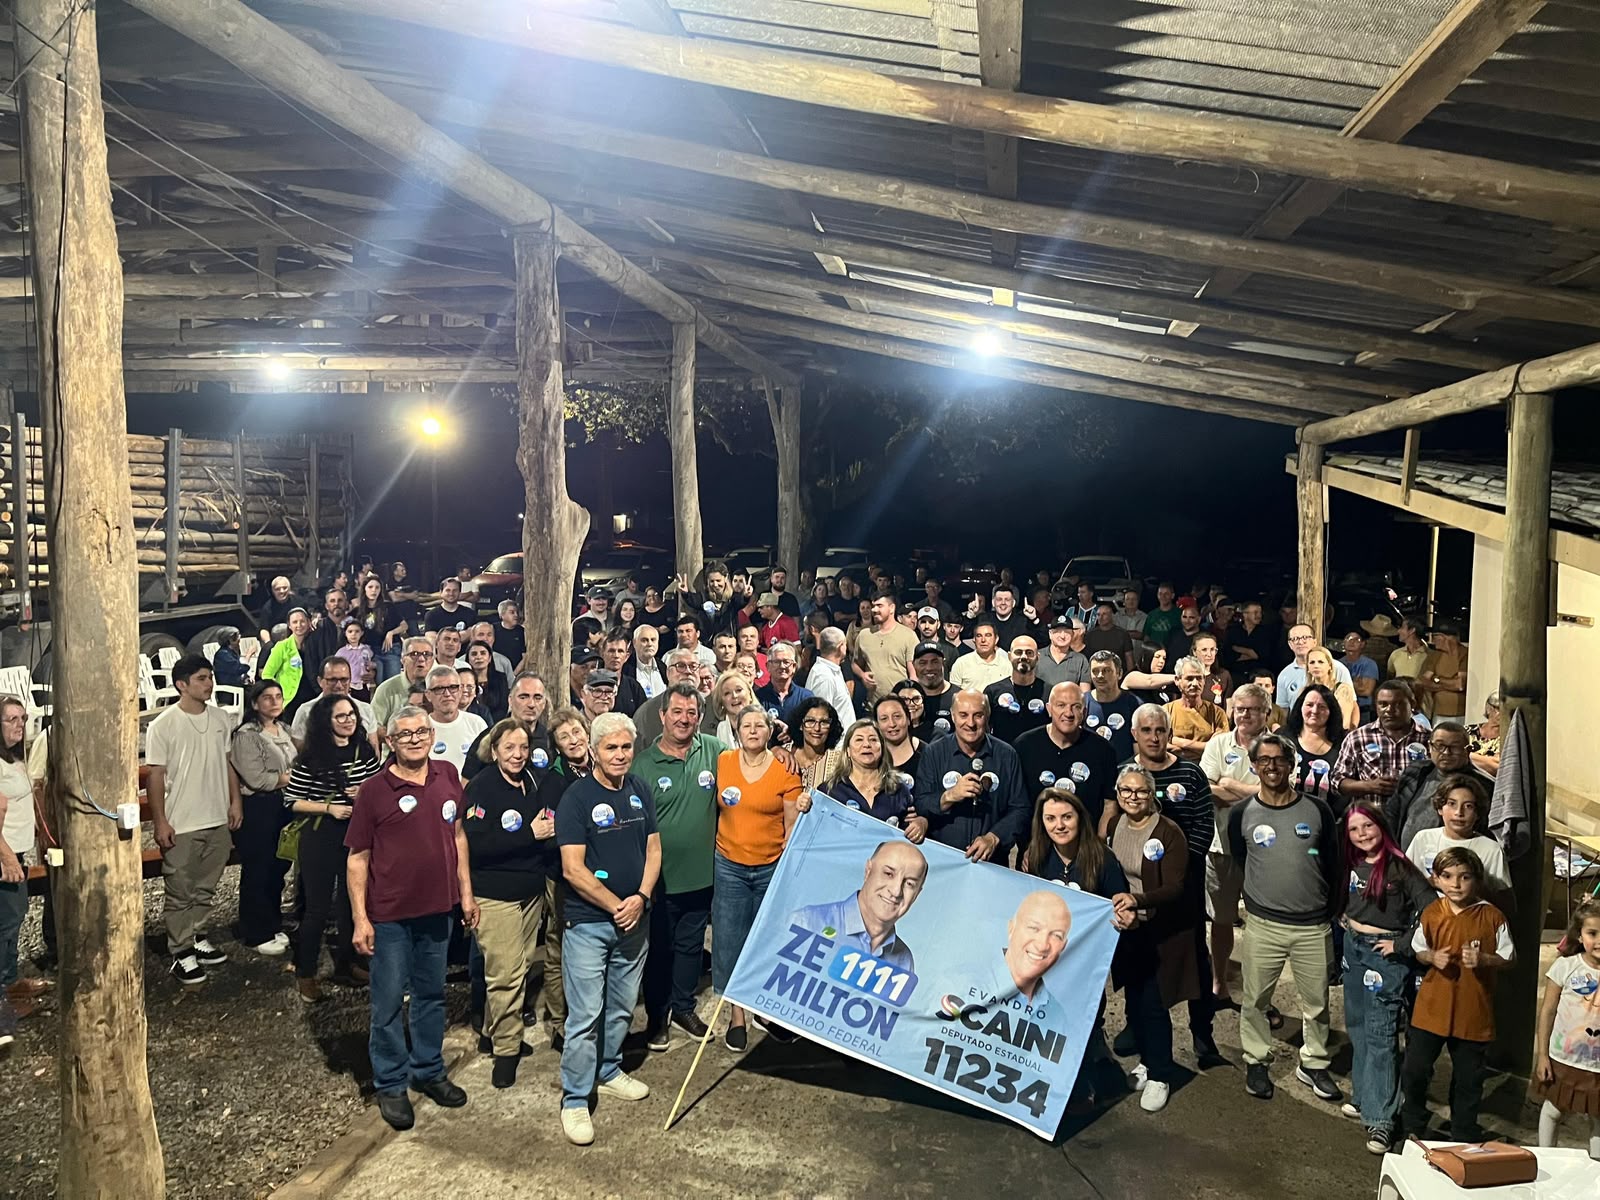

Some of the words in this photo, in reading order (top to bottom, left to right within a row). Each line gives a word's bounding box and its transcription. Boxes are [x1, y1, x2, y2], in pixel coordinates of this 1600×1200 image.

[776, 924, 837, 973] ZÉ
[763, 962, 899, 1042] MILTON
[840, 952, 909, 1002] 1111
[969, 987, 1046, 1020] EVANDRO
[755, 994, 825, 1031] DEPUTADO
[827, 1026, 882, 1057] FEDERAL
[935, 994, 1067, 1064] SCAINI
[941, 1026, 992, 1051] DEPUTADO
[994, 1047, 1042, 1073] ESTADUAL
[924, 1037, 1050, 1119] 11234
